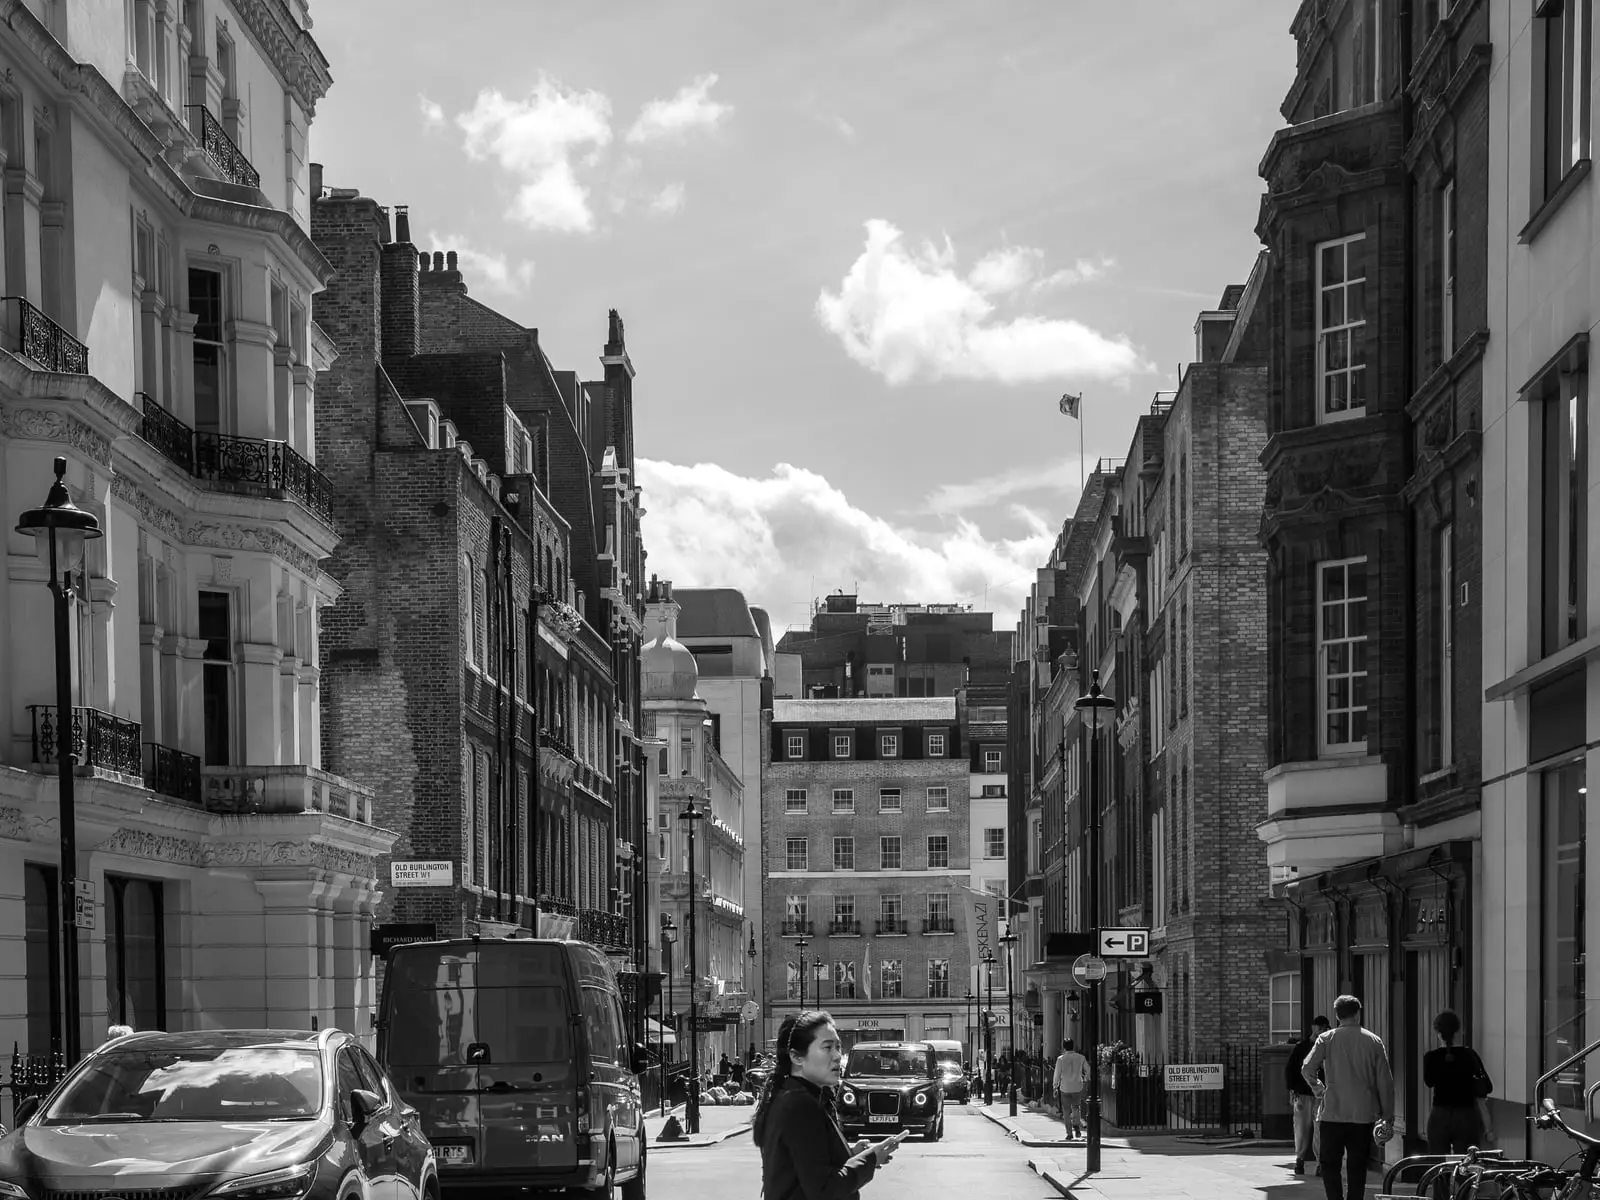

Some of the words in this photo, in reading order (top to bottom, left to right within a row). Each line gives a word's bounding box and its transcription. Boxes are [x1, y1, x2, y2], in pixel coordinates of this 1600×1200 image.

[409, 863, 449, 871] BURLINGTON
[395, 871, 418, 879] STREET
[974, 902, 989, 959] ESKENAZI
[1131, 935, 1143, 951] P
[858, 1020, 879, 1028] DIOR
[1168, 1067, 1180, 1075] OLD
[1181, 1066, 1220, 1074] BURLINGTON
[1168, 1075, 1190, 1083] STREET
[525, 1134, 564, 1143] MAN
